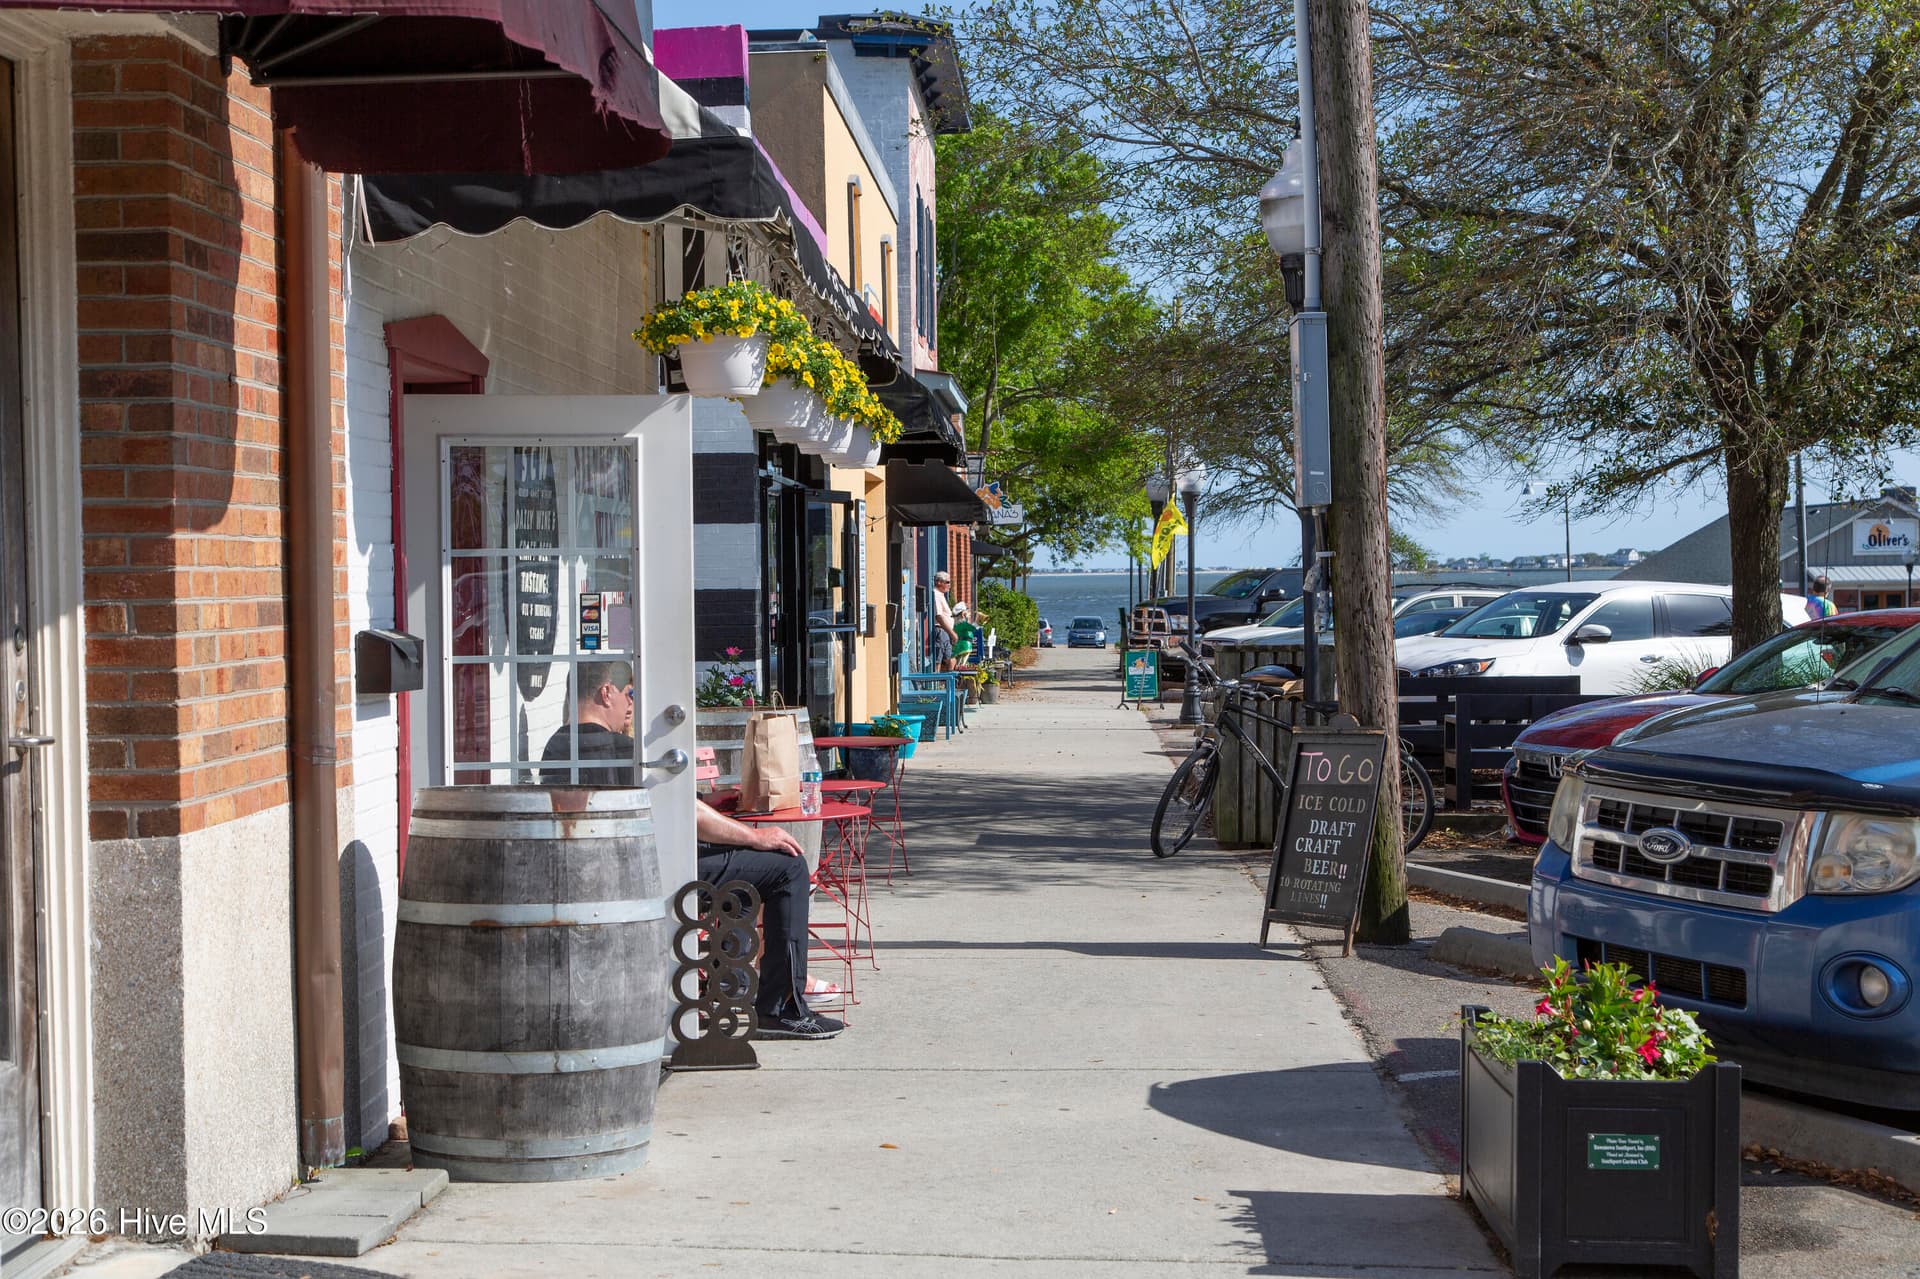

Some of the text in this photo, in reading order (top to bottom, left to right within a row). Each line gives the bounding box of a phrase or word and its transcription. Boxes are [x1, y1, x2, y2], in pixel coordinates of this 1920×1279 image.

[1299, 752, 1332, 782] TO
[1338, 754, 1374, 784] GO
[1298, 794, 1366, 813] ICE COLD
[1308, 819, 1357, 838] DRAFT
[1295, 836, 1342, 856] CRAFT
[1645, 836, 1671, 853] Ford
[1303, 858, 1347, 880] BEER!!
[1292, 877, 1342, 894] ROTATING
